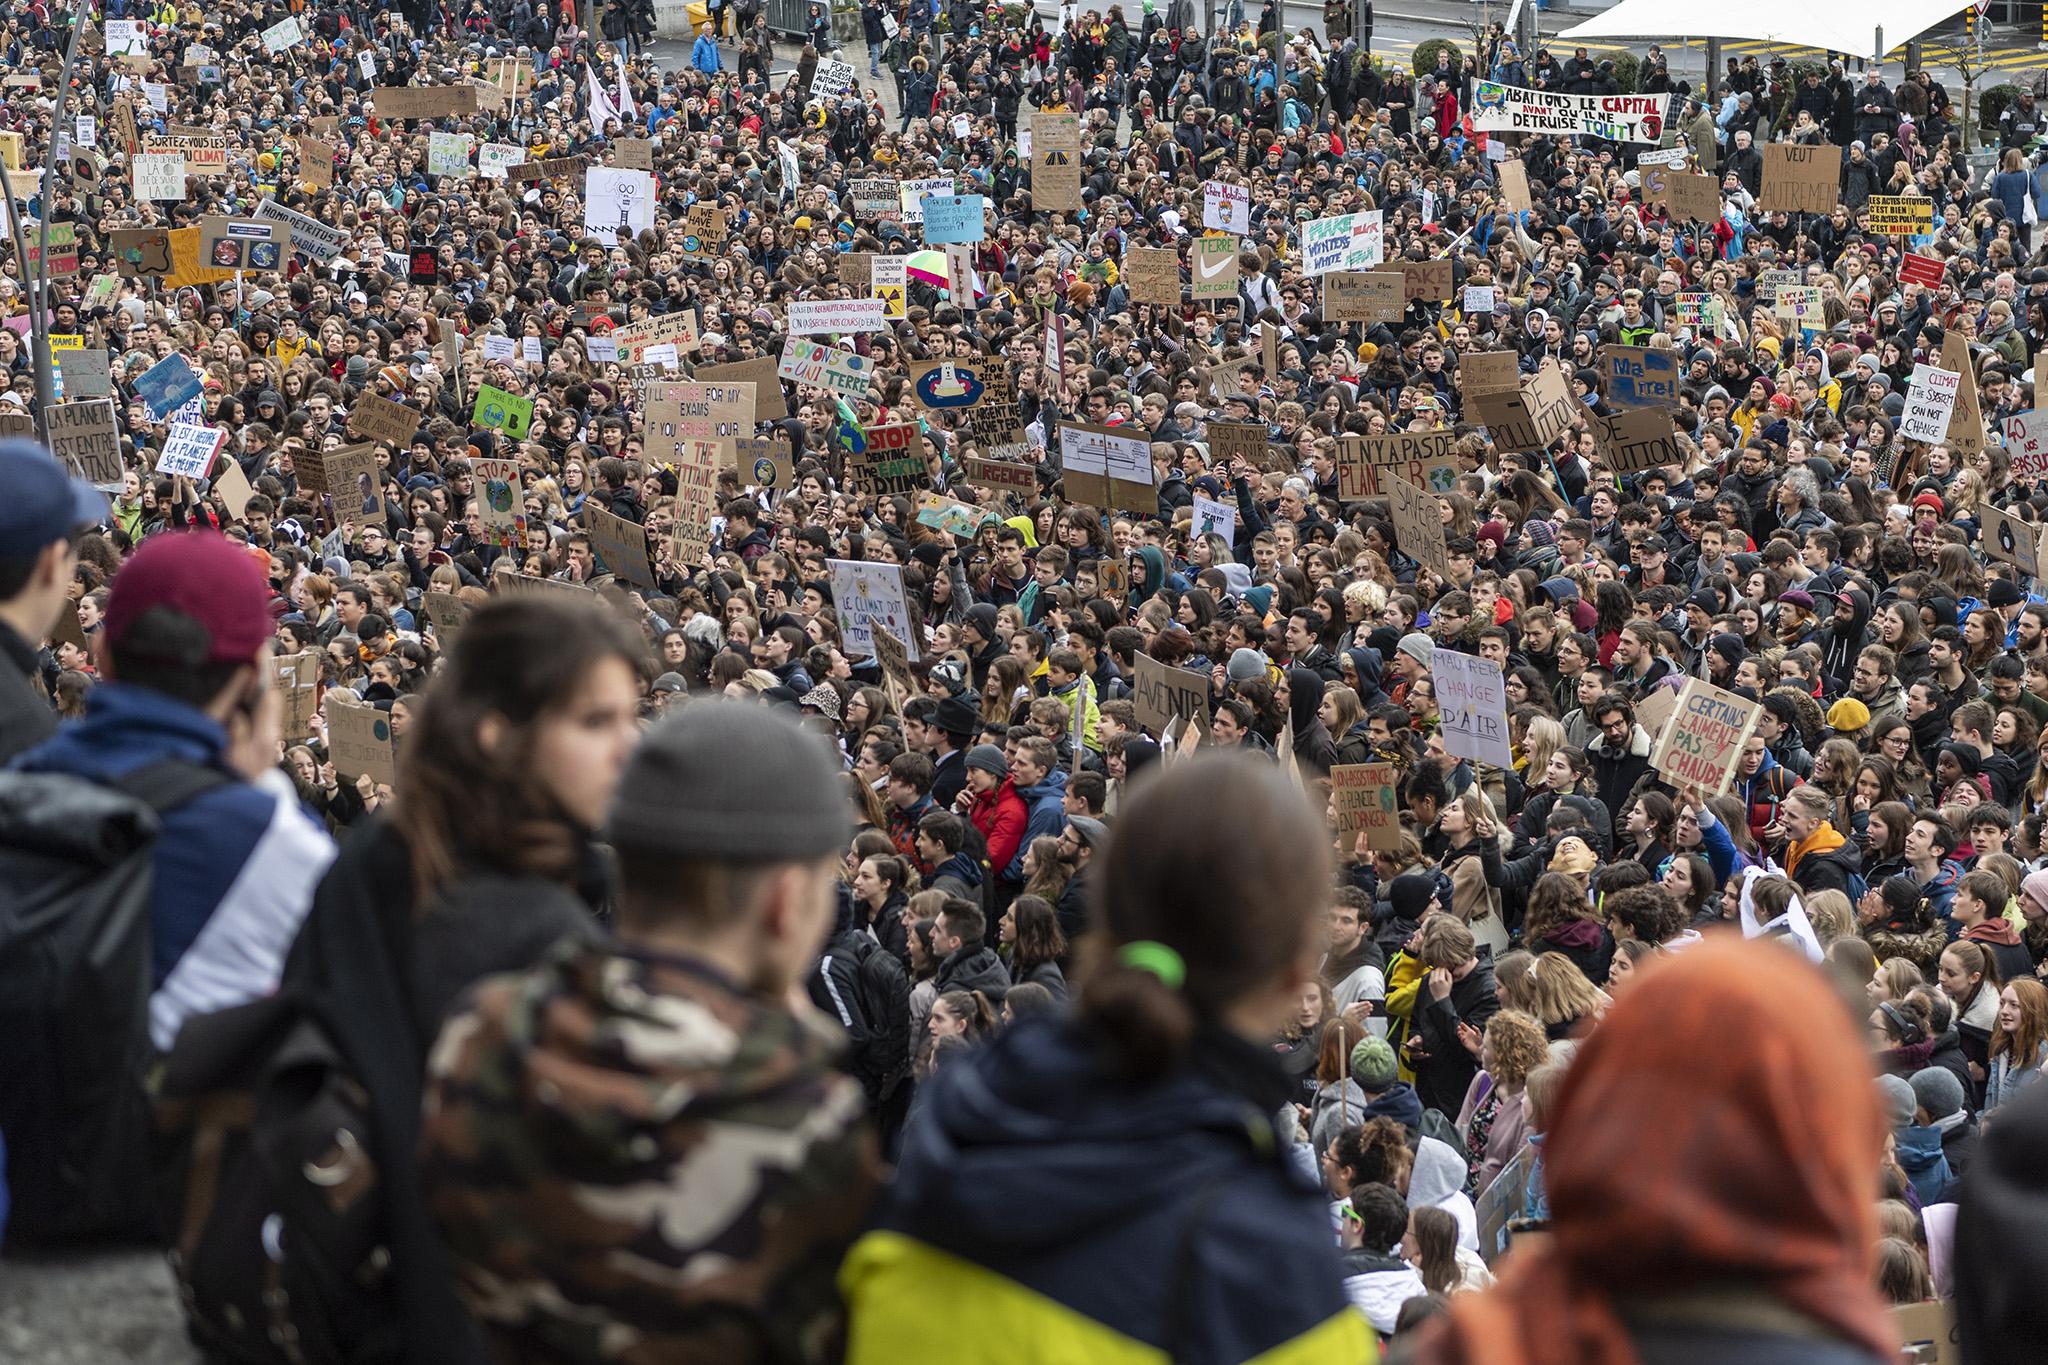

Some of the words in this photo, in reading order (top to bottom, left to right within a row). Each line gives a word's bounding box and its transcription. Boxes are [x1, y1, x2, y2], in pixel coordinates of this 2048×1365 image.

[818, 66, 830, 76] UNE
[830, 70, 852, 82] SUISSE
[830, 62, 852, 74] POUR
[812, 84, 822, 92] EN
[1506, 88, 1571, 108] ABATTONS
[1580, 98, 1596, 110] LE
[1602, 98, 1660, 114] CAPITAL
[1513, 112, 1578, 130] DETRUISE
[1522, 104, 1552, 115] AVANT
[1558, 109, 1596, 120] QU'IL
[1598, 112, 1614, 124] NE
[148, 136, 209, 148] SORTEZ-VOUS
[211, 136, 225, 148] LES
[193, 150, 225, 163] CLIMAT
[432, 151, 468, 169] CHAUD
[1784, 148, 1816, 164] VEUT
[148, 164, 160, 176] LA
[148, 186, 162, 198] LA
[914, 182, 924, 190] DE
[927, 180, 952, 190] NATURE
[1761, 181, 1838, 213] AUTREMENT
[1870, 196, 1880, 205] LES
[1882, 198, 1901, 206] ACTES
[1902, 198, 1932, 206] CITOYENS
[700, 208, 714, 218] WE
[904, 212, 916, 221] PAS
[1870, 206, 1888, 214] C'EST
[1890, 206, 1907, 214] BIEN
[689, 214, 712, 228] HAVE
[1870, 224, 1888, 232] C'EST
[1890, 224, 1913, 233] MIEUX
[1880, 216, 1900, 224] ACTES
[697, 228, 720, 240] ONLY
[1199, 238, 1234, 253] TERRE
[1308, 235, 1351, 257] WINTERS
[1314, 252, 1342, 270] WHITE
[1764, 273, 1788, 282] CHERCHE
[1404, 287, 1426, 298] UP
[1676, 294, 1712, 303] SAUVONS
[1678, 304, 1702, 313] NOTRE
[626, 322, 653, 336] This
[657, 313, 685, 329] planet
[654, 327, 672, 340] you
[676, 322, 686, 332] to
[784, 340, 842, 366] SOYONS
[631, 363, 656, 379] T'ES
[984, 364, 1004, 374] YOU
[826, 368, 868, 394] TERRE
[979, 374, 994, 382] SEE
[1929, 372, 1959, 389] CLIMAT
[668, 386, 701, 402] REVISE
[706, 387, 723, 403] FOR
[728, 388, 741, 403] MY
[185, 401, 198, 412] OF
[516, 399, 525, 410] NO
[680, 402, 710, 417] EXAMS
[1008, 404, 1022, 415] NE
[46, 408, 63, 430] LA
[508, 414, 518, 430] B
[1911, 406, 1926, 416] CAN
[1927, 409, 1944, 422] NOT
[648, 422, 656, 434] IF
[660, 422, 677, 438] YOU
[680, 422, 711, 436] REVISE
[715, 422, 739, 438] YOUR
[1486, 396, 1577, 451] POLLUTION
[1905, 419, 1940, 440] CHANGE
[178, 427, 191, 440] EST
[868, 424, 914, 450] STOP
[976, 434, 992, 450] PAS
[993, 432, 1013, 448] UNE
[1210, 426, 1236, 440] C'EST
[1240, 428, 1268, 442] NOUS
[53, 436, 72, 458] EST
[76, 432, 116, 452] ENTRE
[167, 441, 178, 454] LA
[694, 441, 717, 466] THE
[988, 442, 1030, 460] BANQUISE
[1210, 441, 1266, 458] L'AVENIR
[1336, 440, 1358, 464] IL
[1360, 440, 1383, 464] N'Y
[1389, 440, 1399, 462] A
[1402, 437, 1433, 461] PAS
[1436, 434, 1456, 458] DE
[865, 448, 910, 464] DENYING
[680, 462, 715, 489] TITANIC
[852, 464, 878, 479] The
[878, 457, 925, 478] EARTH
[970, 463, 1033, 487] URGENCE
[1408, 460, 1427, 490] B
[873, 472, 930, 495] DYING
[684, 486, 709, 505] WOULD
[1396, 481, 1427, 527] SAVE
[674, 500, 696, 523] HAVE
[696, 503, 710, 525] NO
[672, 520, 710, 545] PROBLEMS
[672, 541, 681, 562] IN
[681, 543, 704, 565] 2019
[842, 596, 852, 610] LE
[855, 597, 883, 614] CLIMAT
[852, 627, 869, 642] TOUT
[1436, 676, 1496, 704] CHANGE
[1136, 671, 1207, 728] AVENIR
[1687, 694, 1747, 729] CERTAINS
[1673, 730, 1702, 754] PAS
[1666, 750, 1727, 790] CHAUDE
[1340, 812, 1354, 832] EN
[1354, 810, 1388, 831] DANGER
